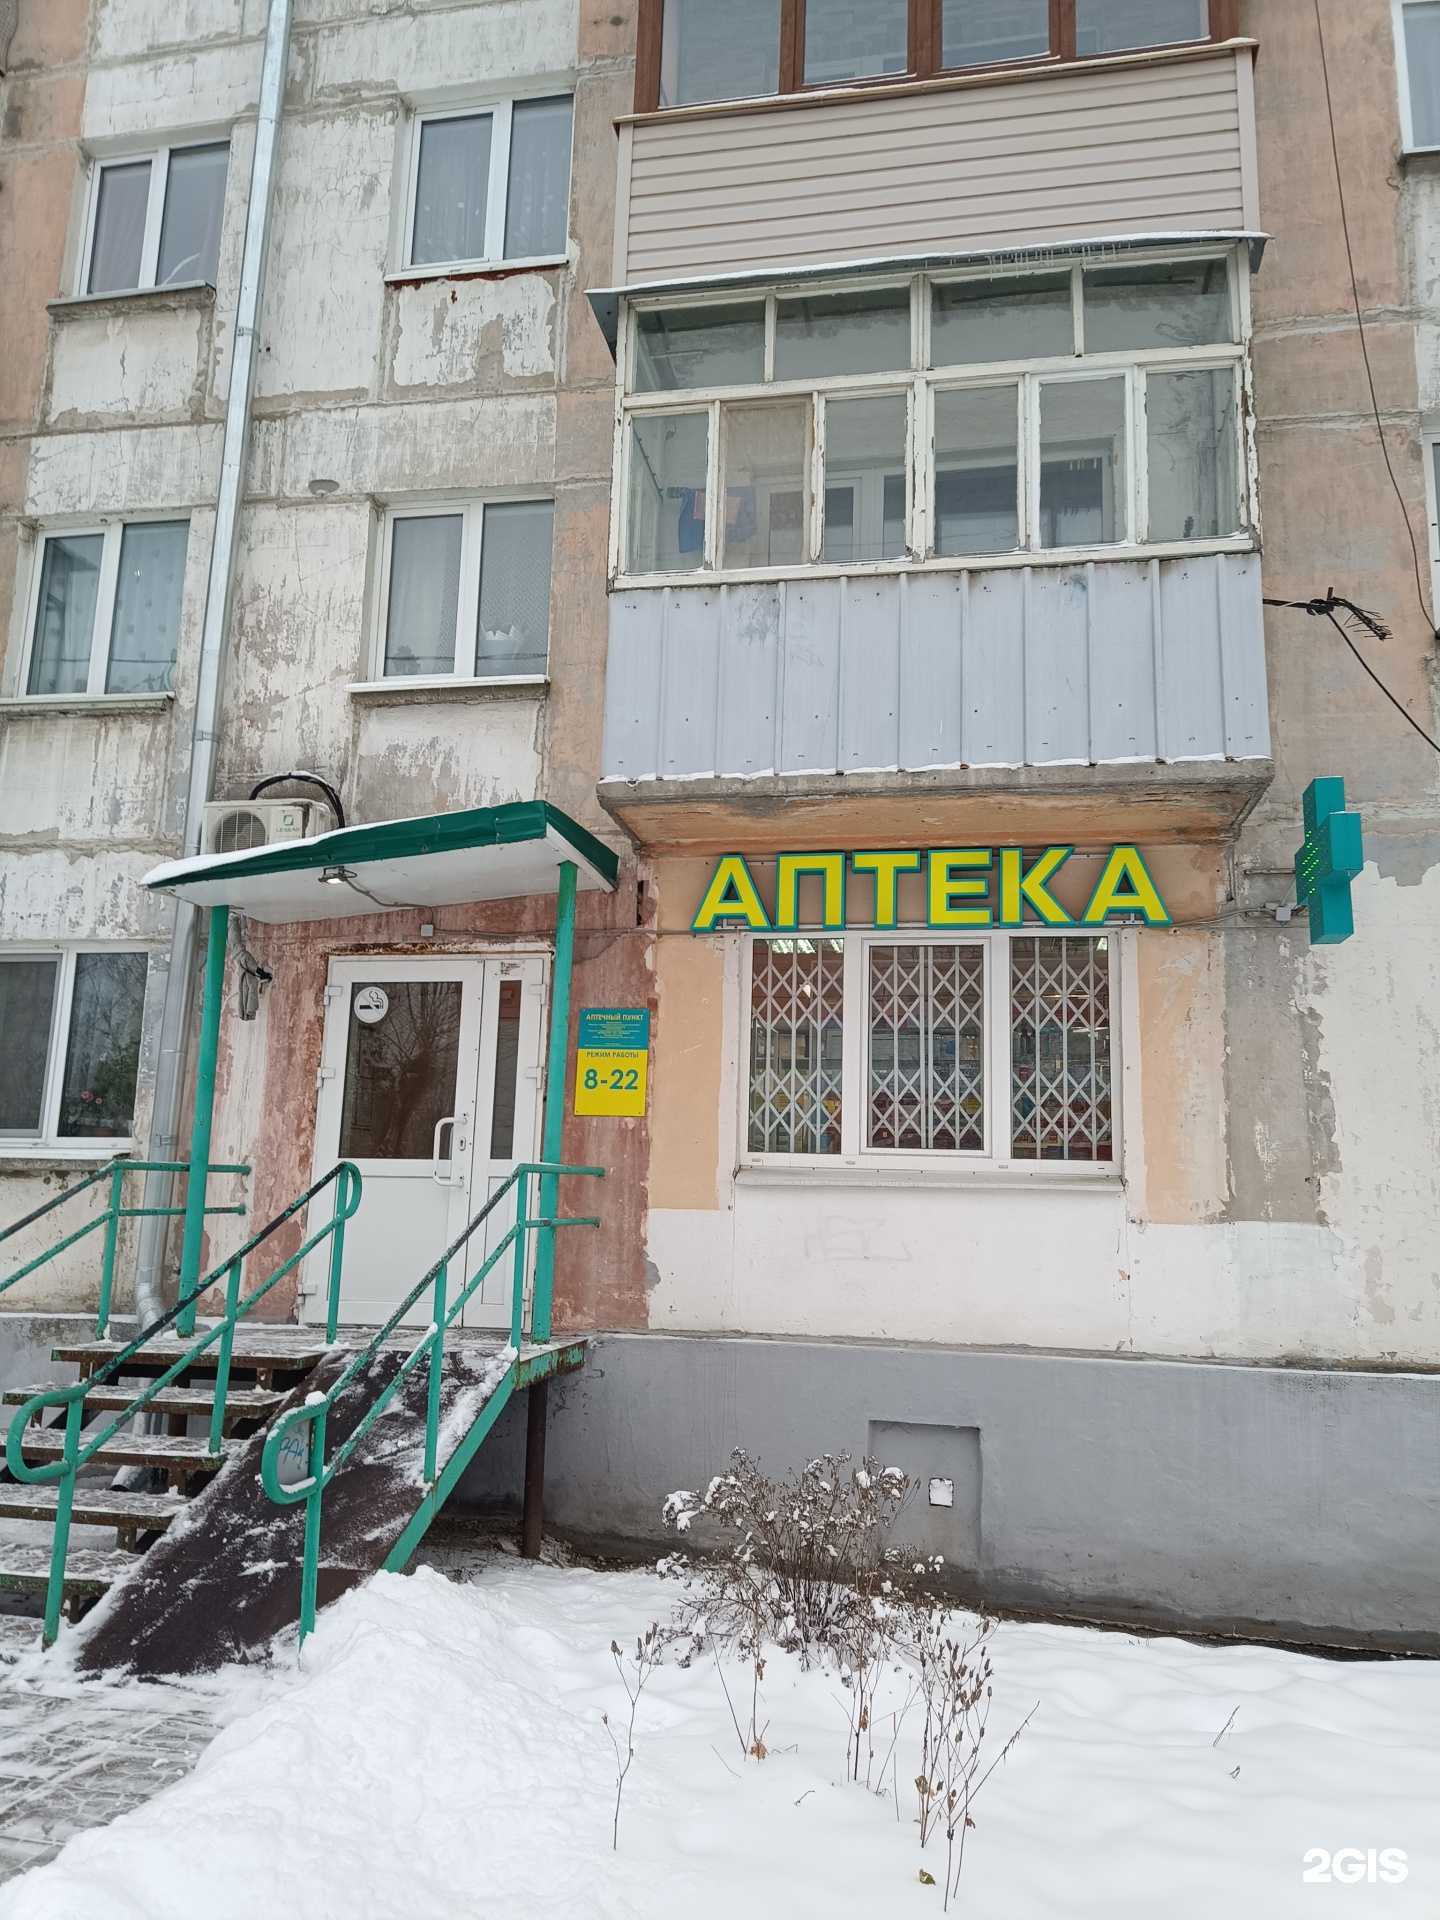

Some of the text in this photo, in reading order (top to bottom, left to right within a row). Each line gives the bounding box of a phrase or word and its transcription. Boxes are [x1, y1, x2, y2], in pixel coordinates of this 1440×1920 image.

[690, 845, 1173, 931] АПТЕКА
[586, 1012, 621, 1021] АПТЕЧНЫЙ
[584, 1068, 639, 1090] 8-22
